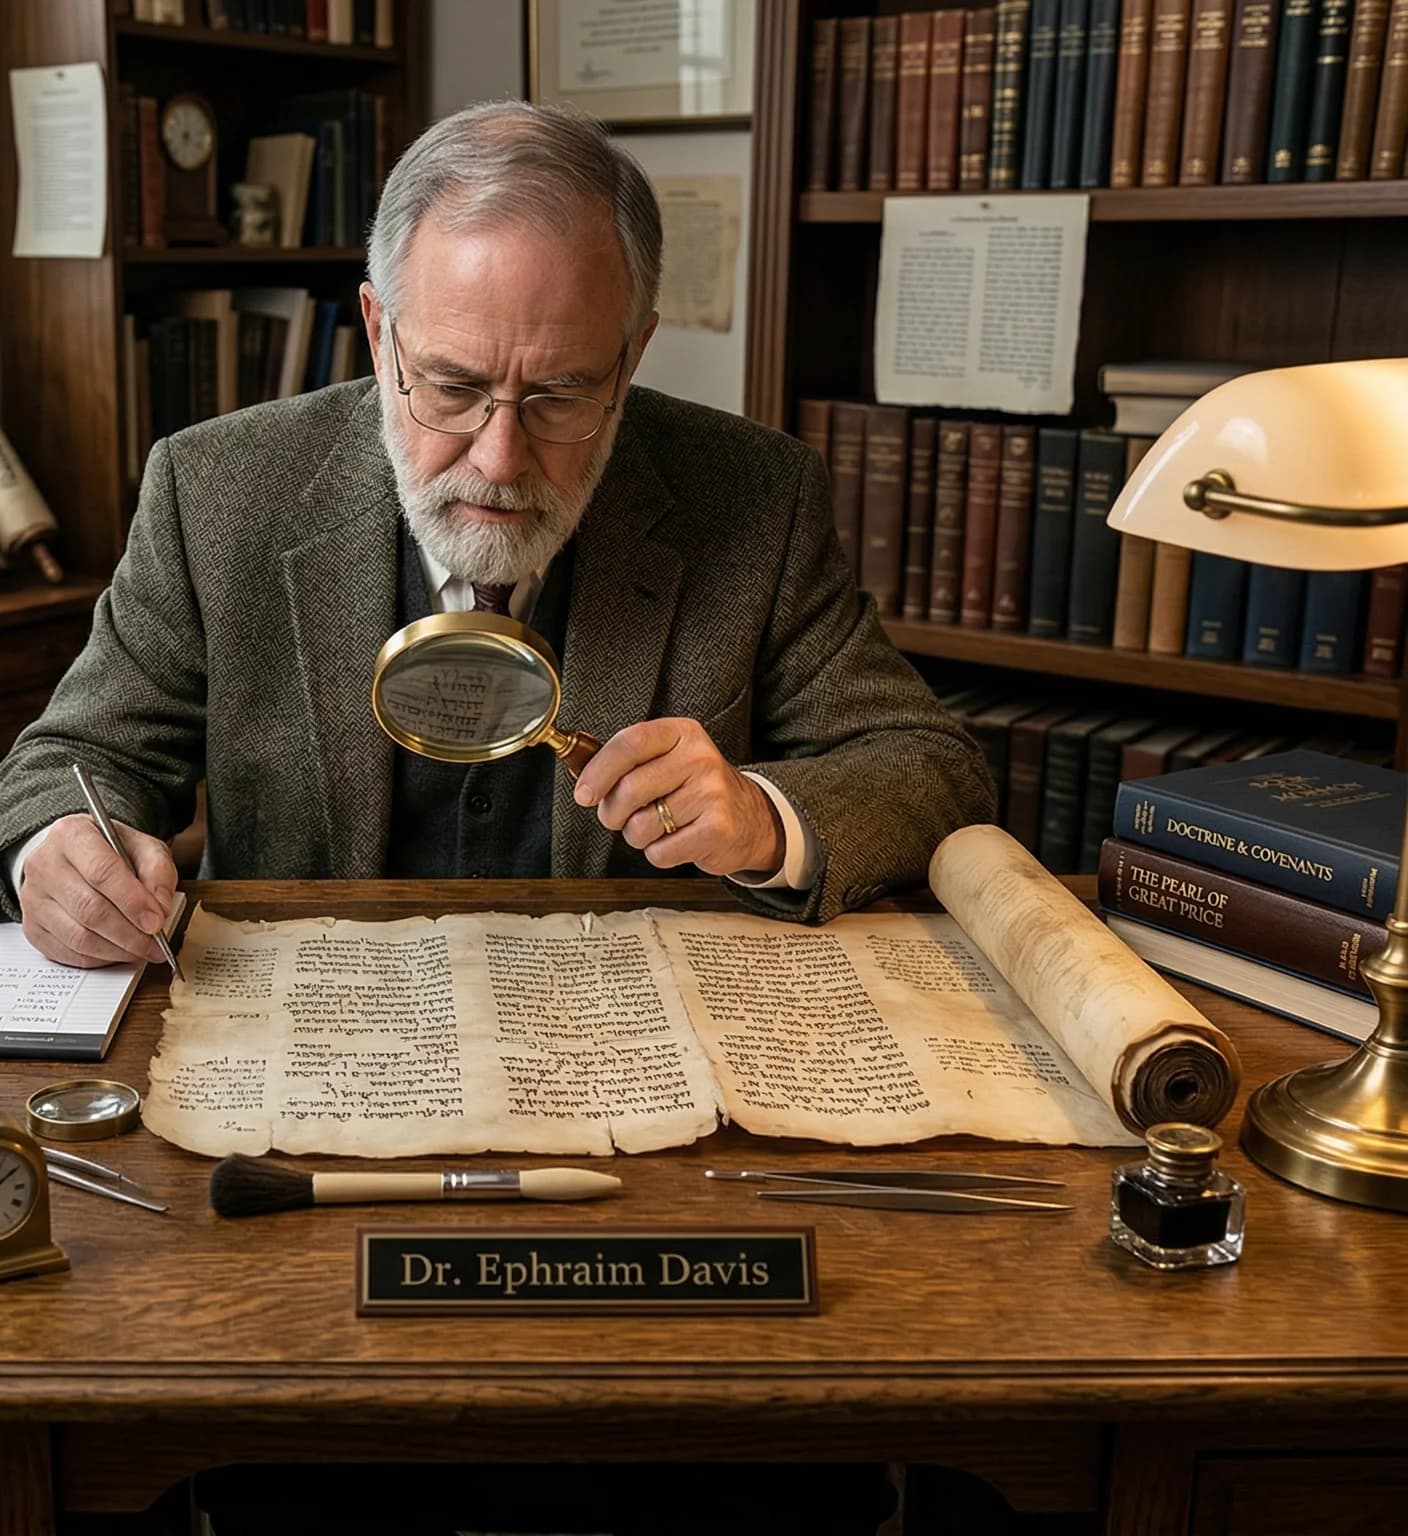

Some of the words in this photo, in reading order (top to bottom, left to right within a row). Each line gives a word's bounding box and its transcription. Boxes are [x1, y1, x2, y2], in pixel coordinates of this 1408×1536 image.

[1167, 819, 1235, 852] DOCTRINE
[1237, 841, 1249, 856] &
[1252, 845, 1334, 881] COVENANTS
[1128, 885, 1178, 914] GREAT
[1180, 903, 1224, 929] PRICE
[1130, 866, 1159, 886] THE
[1162, 876, 1204, 902] PEARL
[1208, 891, 1228, 909] OF
[400, 1253, 462, 1286] Dr.
[477, 1252, 645, 1294] Ephraim
[659, 1252, 770, 1286] Davis
